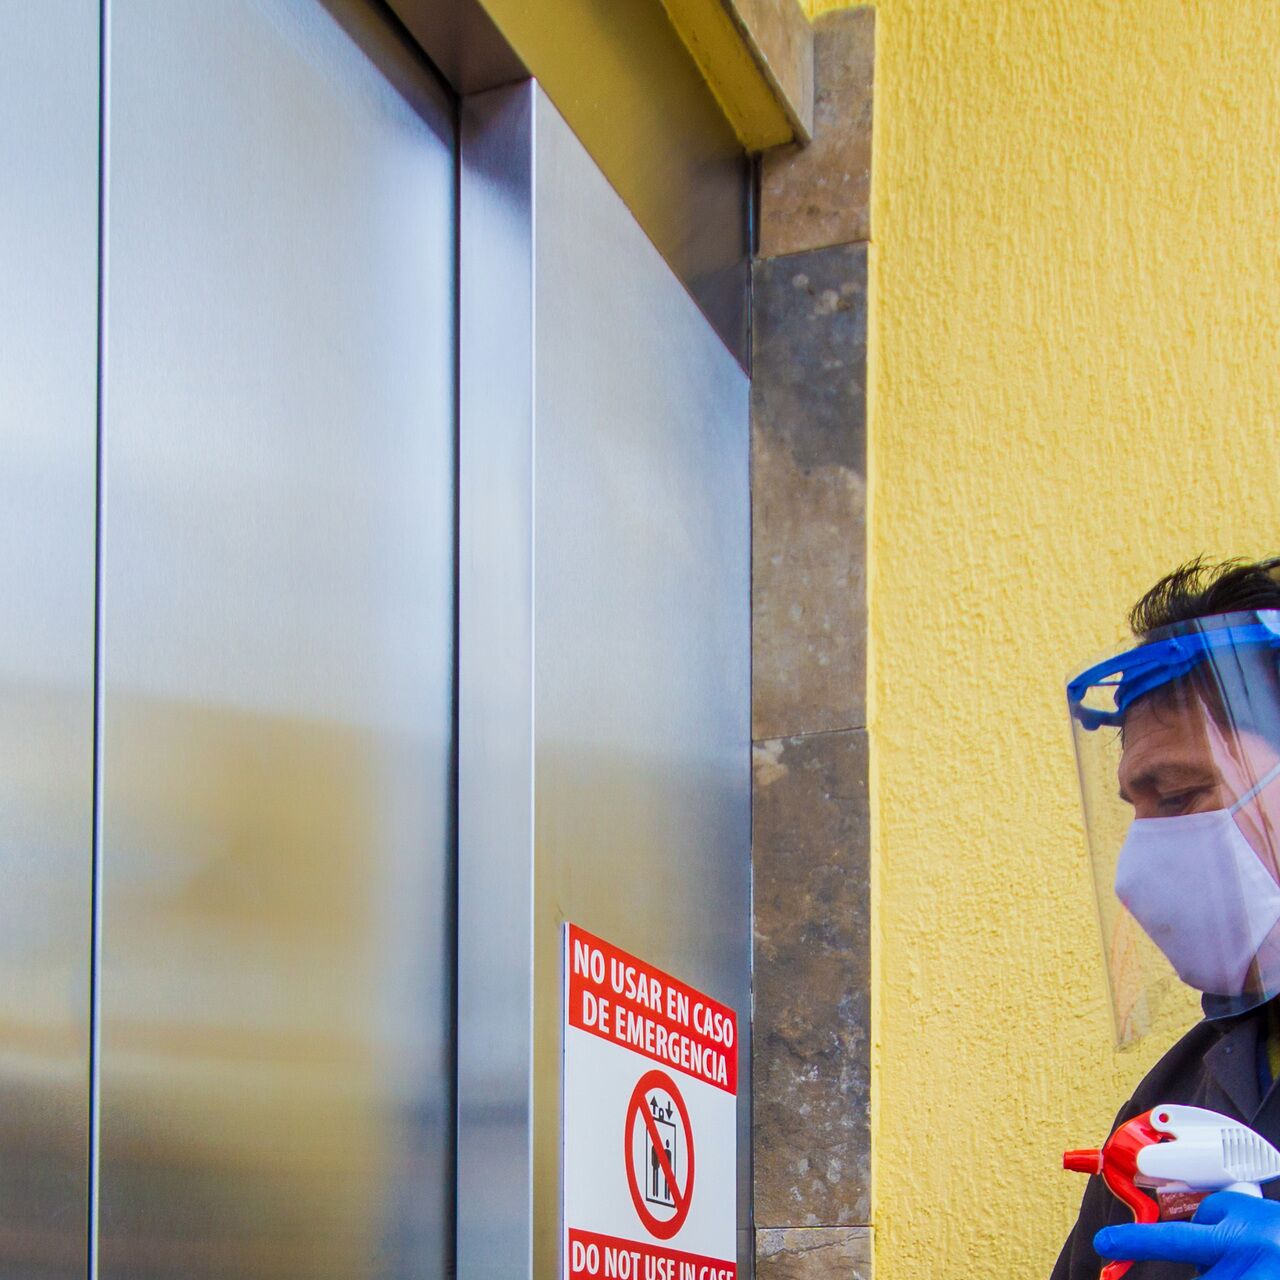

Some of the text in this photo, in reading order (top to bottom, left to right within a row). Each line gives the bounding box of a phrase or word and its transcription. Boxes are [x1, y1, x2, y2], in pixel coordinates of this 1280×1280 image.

[574, 939, 734, 1048] NO USAR EN CASO
[583, 990, 728, 1086] DE EMERGENCIA
[572, 1240, 600, 1275] DO
[605, 1246, 641, 1280] NOT
